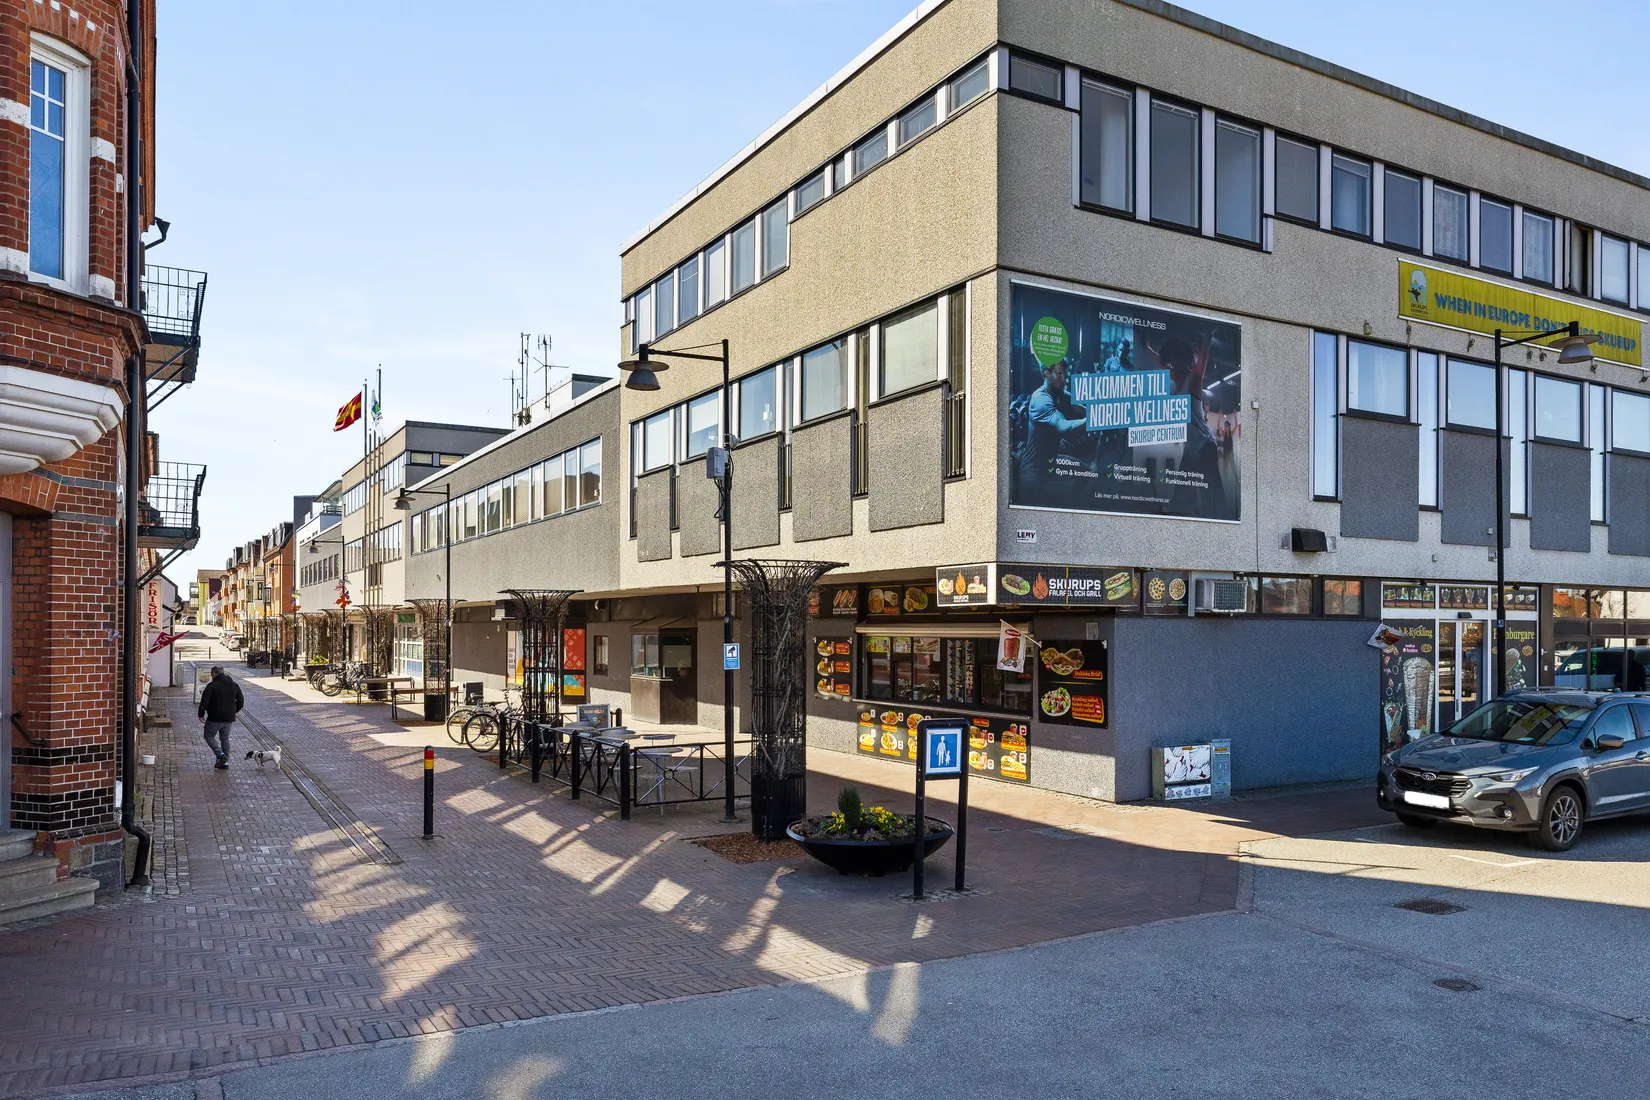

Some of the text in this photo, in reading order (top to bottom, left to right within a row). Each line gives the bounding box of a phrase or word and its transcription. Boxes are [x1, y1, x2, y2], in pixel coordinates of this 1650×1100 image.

[1098, 311, 1167, 331] NORDICWELLNESS
[1434, 292, 1472, 316] WHEN
[1474, 301, 1487, 319] IN
[1488, 304, 1531, 329] EUROPE
[1597, 330, 1637, 352] SKURUP
[1074, 371, 1168, 401] VÄLKOMMEN TILL
[1089, 398, 1188, 428] NORDIC WELLNESS
[1130, 425, 1185, 444] SKURUP CENTRUM
[1055, 458, 1080, 467] 1000kvm
[1113, 463, 1147, 474] Gruppträning
[1055, 468, 1068, 477] Gym
[1074, 469, 1099, 478] kondition
[1113, 472, 1151, 484] Virtuell träning
[1165, 468, 1205, 480] Personlig träning
[1165, 477, 1209, 489] Funktionell träning
[1048, 578, 1102, 591] SKURUPS
[1048, 589, 1074, 597] FALAFEL
[1086, 590, 1102, 598] GRILL
[147, 582, 158, 624] FRISÖR
